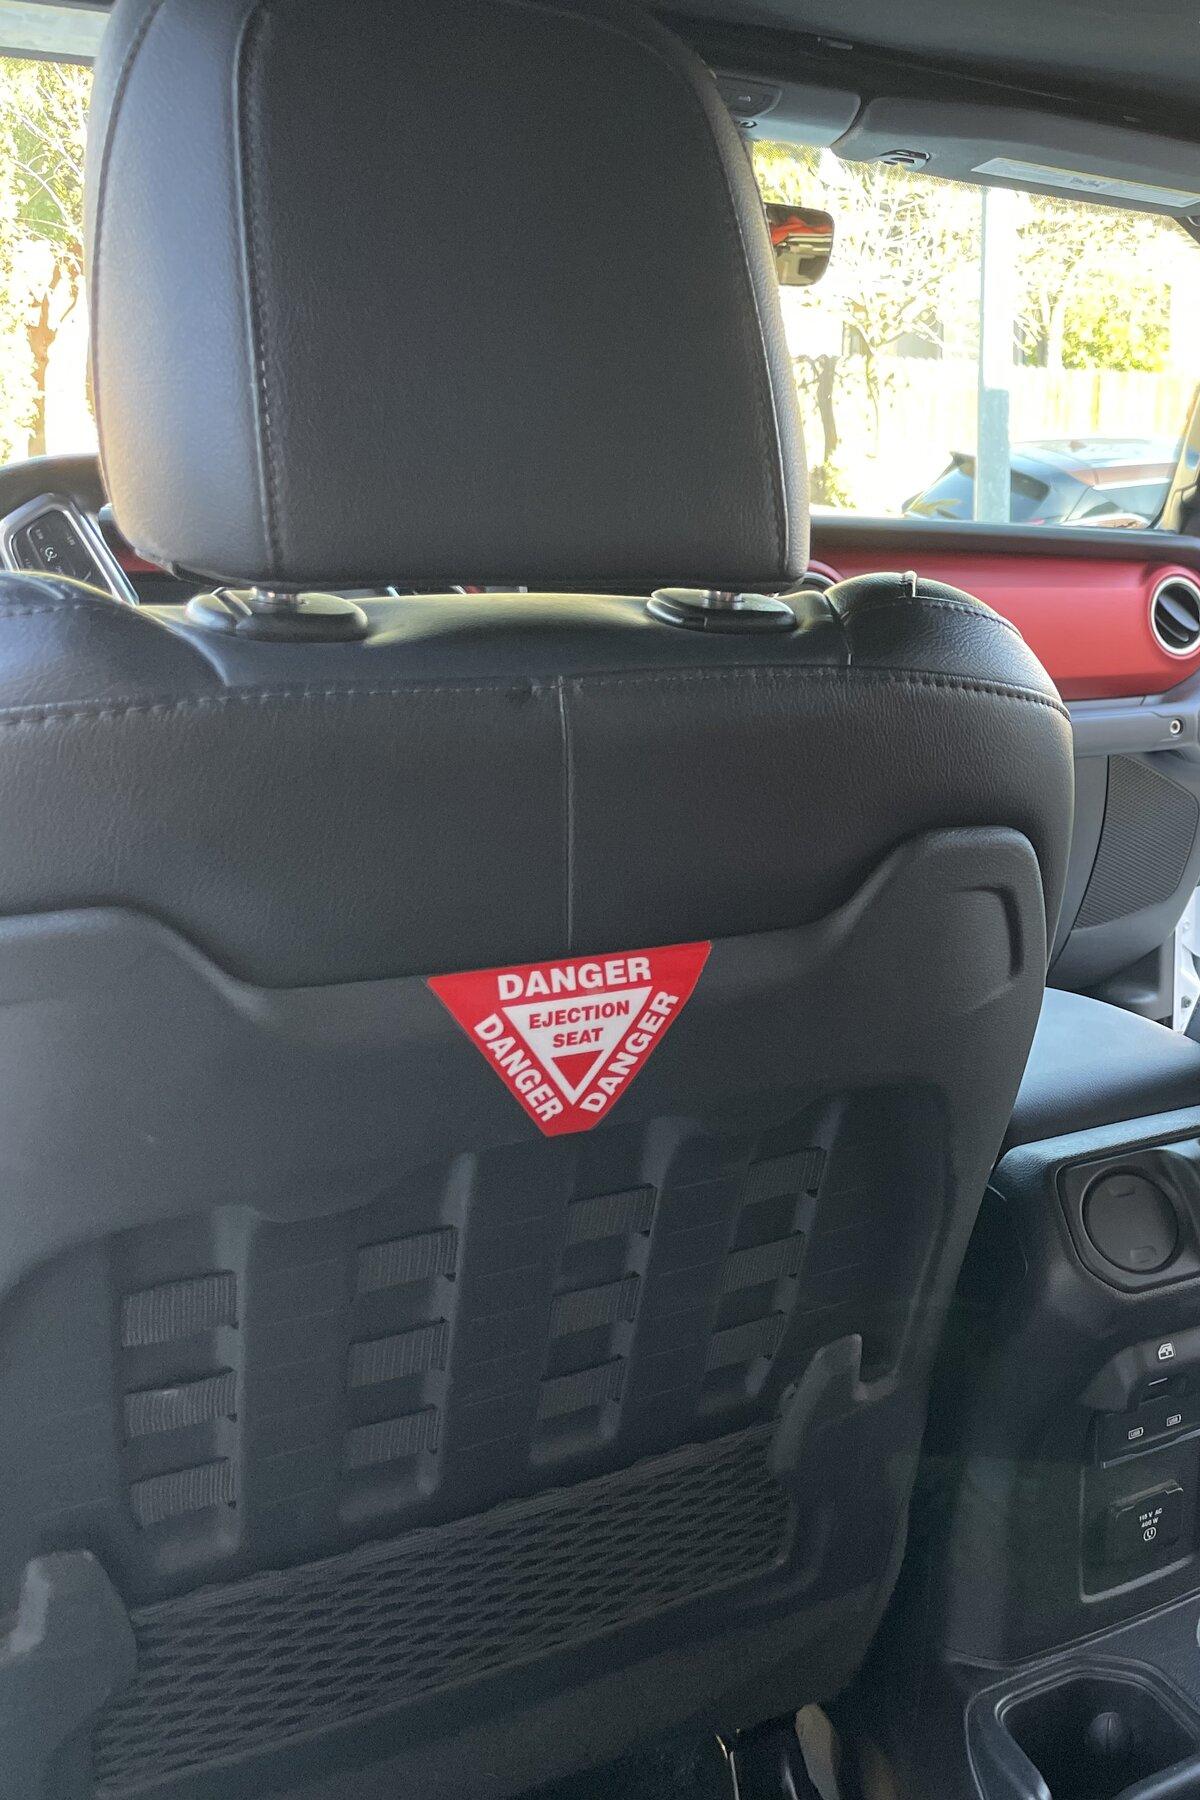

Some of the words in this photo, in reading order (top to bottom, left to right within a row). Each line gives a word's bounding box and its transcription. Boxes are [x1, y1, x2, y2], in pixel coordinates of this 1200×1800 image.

[498, 957, 651, 1001] DANGER
[529, 1000, 630, 1030] EJECTION
[552, 1027, 604, 1048] SEAT
[580, 991, 680, 1113] DANGER
[474, 1013, 563, 1122] DANGER
